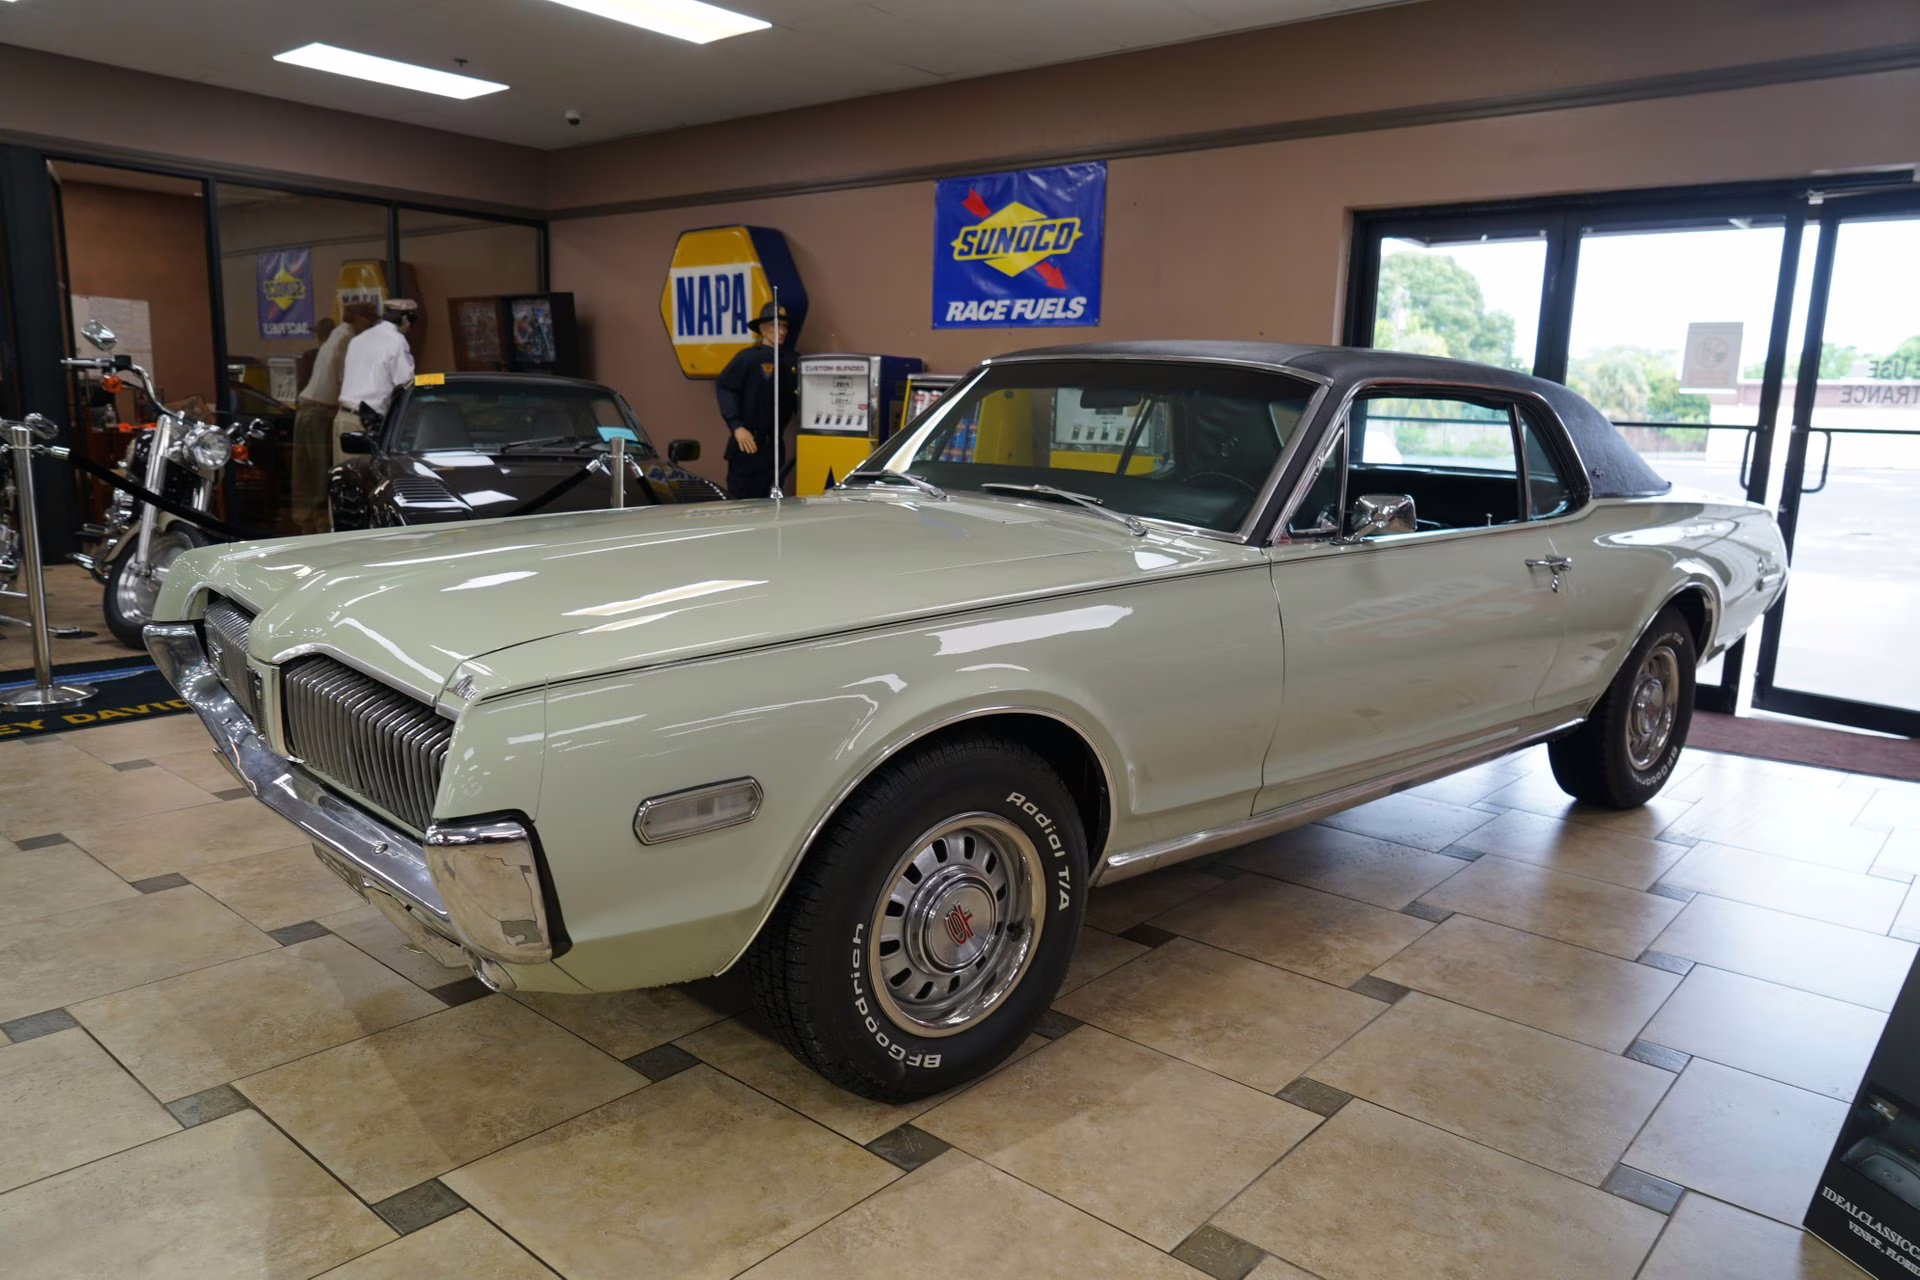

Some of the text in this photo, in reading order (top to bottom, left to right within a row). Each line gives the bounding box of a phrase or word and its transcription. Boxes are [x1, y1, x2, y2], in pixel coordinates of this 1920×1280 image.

[957, 222, 1077, 256] SUNOCO
[676, 272, 748, 337] NAPA
[945, 296, 1087, 322] RACE FUELS
[1005, 791, 1071, 911] Radial T/A
[1821, 1185, 1920, 1261] IDEALCLASSICC
